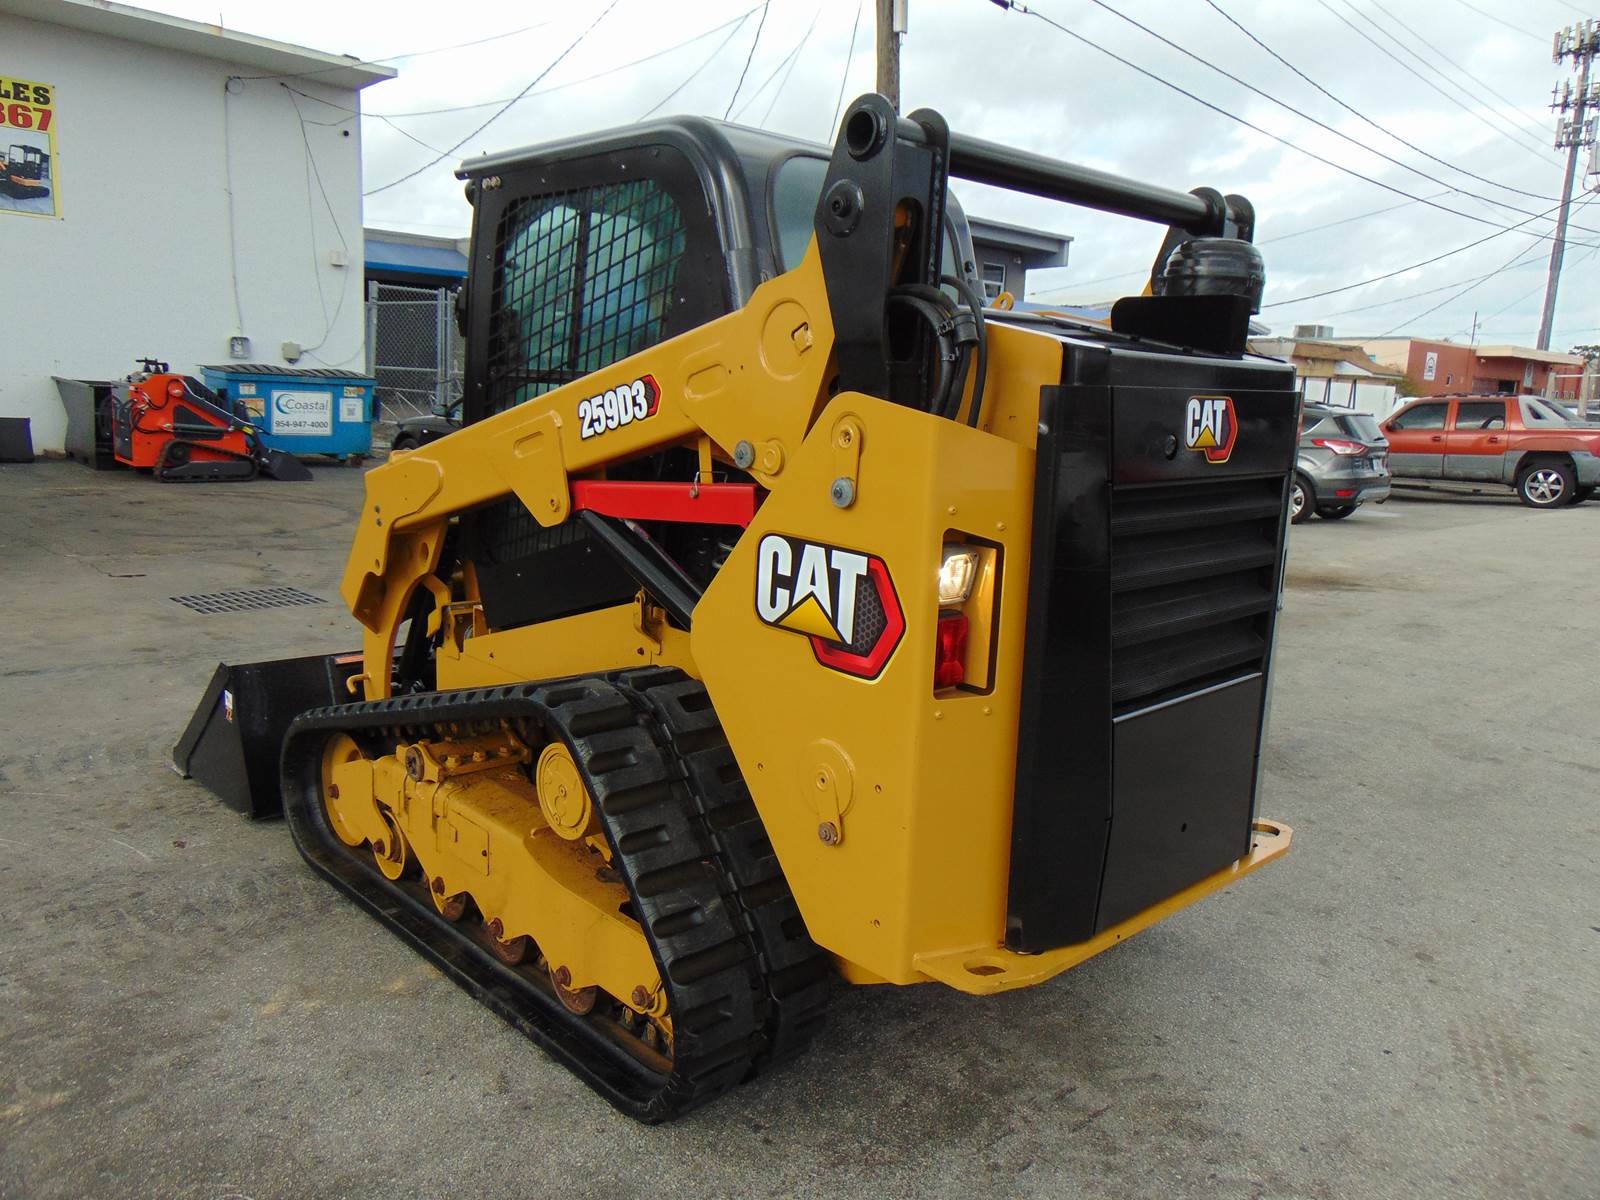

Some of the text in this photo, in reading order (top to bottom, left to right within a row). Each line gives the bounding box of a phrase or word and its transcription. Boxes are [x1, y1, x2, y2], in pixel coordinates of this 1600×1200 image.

[0, 102, 52, 131] 67
[274, 420, 329, 429] 954-947-4000
[286, 399, 328, 411] Coastal
[579, 380, 648, 439] 259D3
[1187, 398, 1226, 447] CAT
[757, 535, 868, 645] CAT
